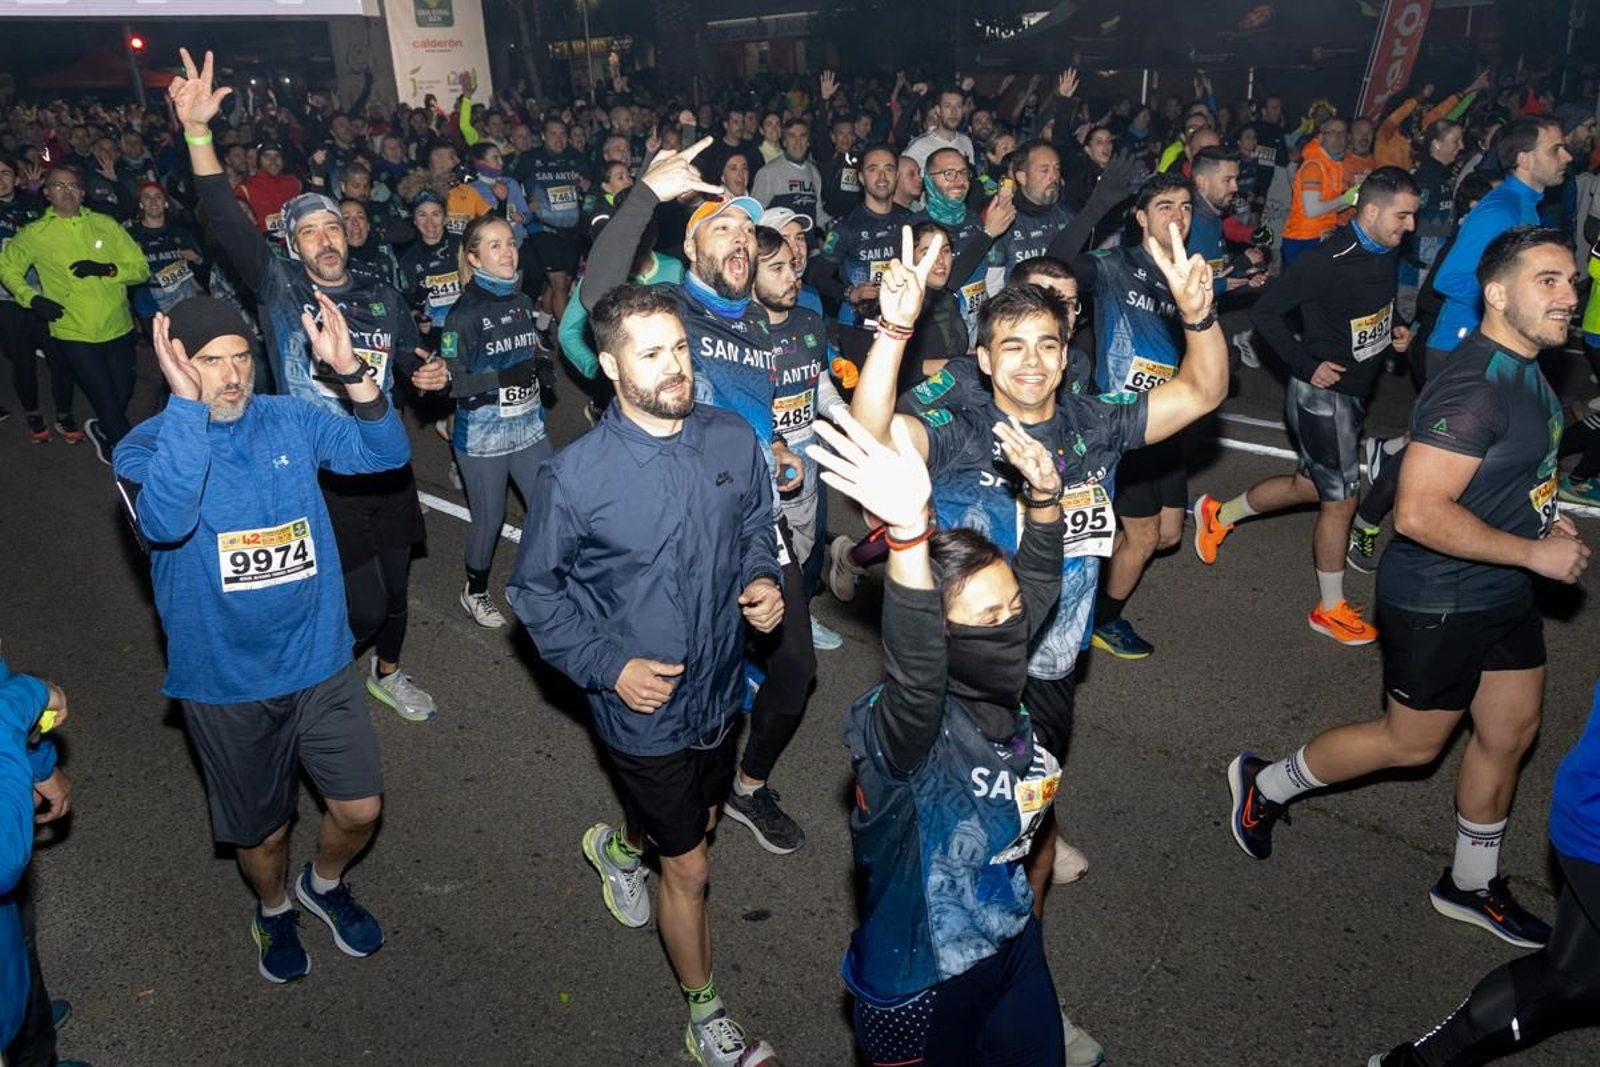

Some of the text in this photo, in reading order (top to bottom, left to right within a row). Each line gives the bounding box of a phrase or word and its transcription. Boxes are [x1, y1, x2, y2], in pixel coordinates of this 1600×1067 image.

[859, 247, 881, 261] SAN
[1126, 290, 1156, 312] SAN
[1358, 316, 1389, 345] 8497
[485, 337, 513, 356] SAN
[700, 336, 739, 362] SAN
[229, 539, 308, 575] 9974
